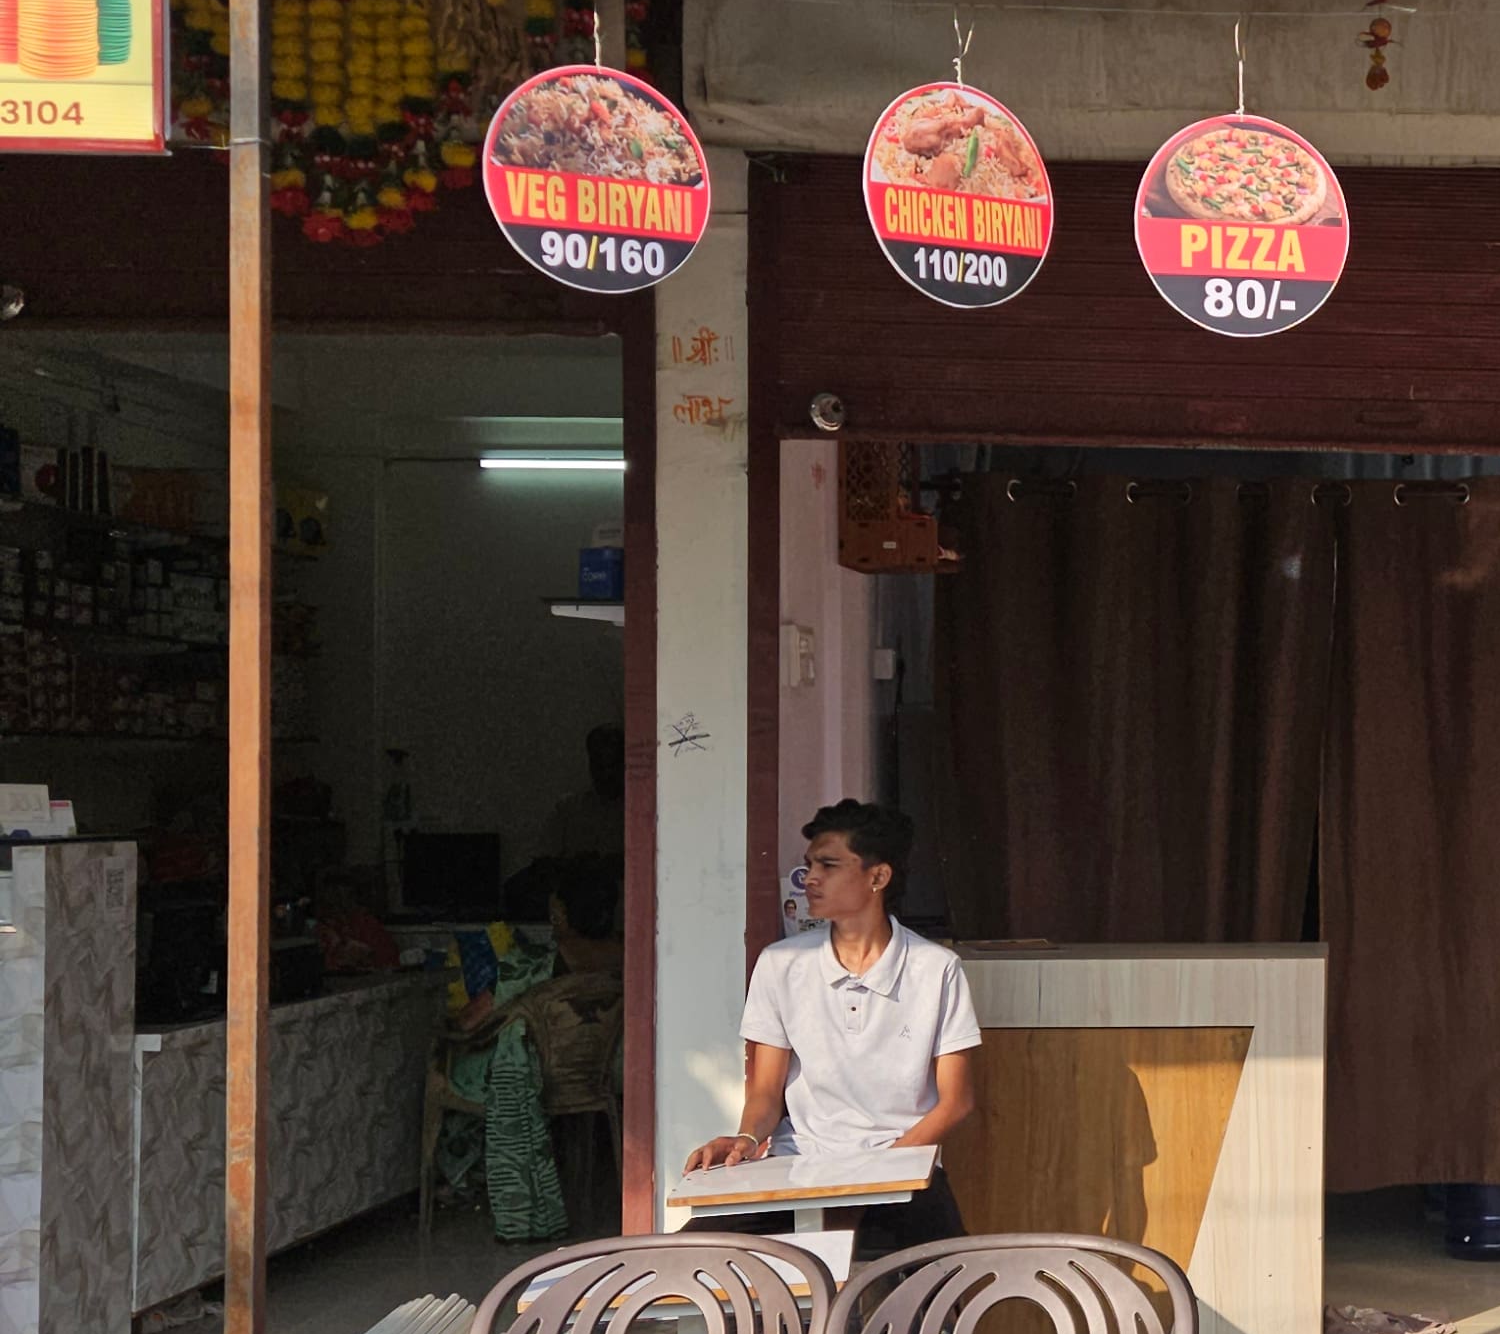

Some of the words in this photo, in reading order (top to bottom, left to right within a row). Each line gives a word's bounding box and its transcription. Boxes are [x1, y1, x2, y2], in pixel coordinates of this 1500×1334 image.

[0, 99, 84, 126] 3104
[504, 170, 567, 222] VEG
[576, 178, 693, 235] BIRYANI
[884, 186, 968, 241] CHICKEN
[973, 198, 1043, 250] BIRYANI
[540, 230, 665, 276] 90/160
[913, 246, 1008, 287] 110/200
[1180, 224, 1306, 273] PIZZA
[1203, 277, 1297, 320] 80/-
